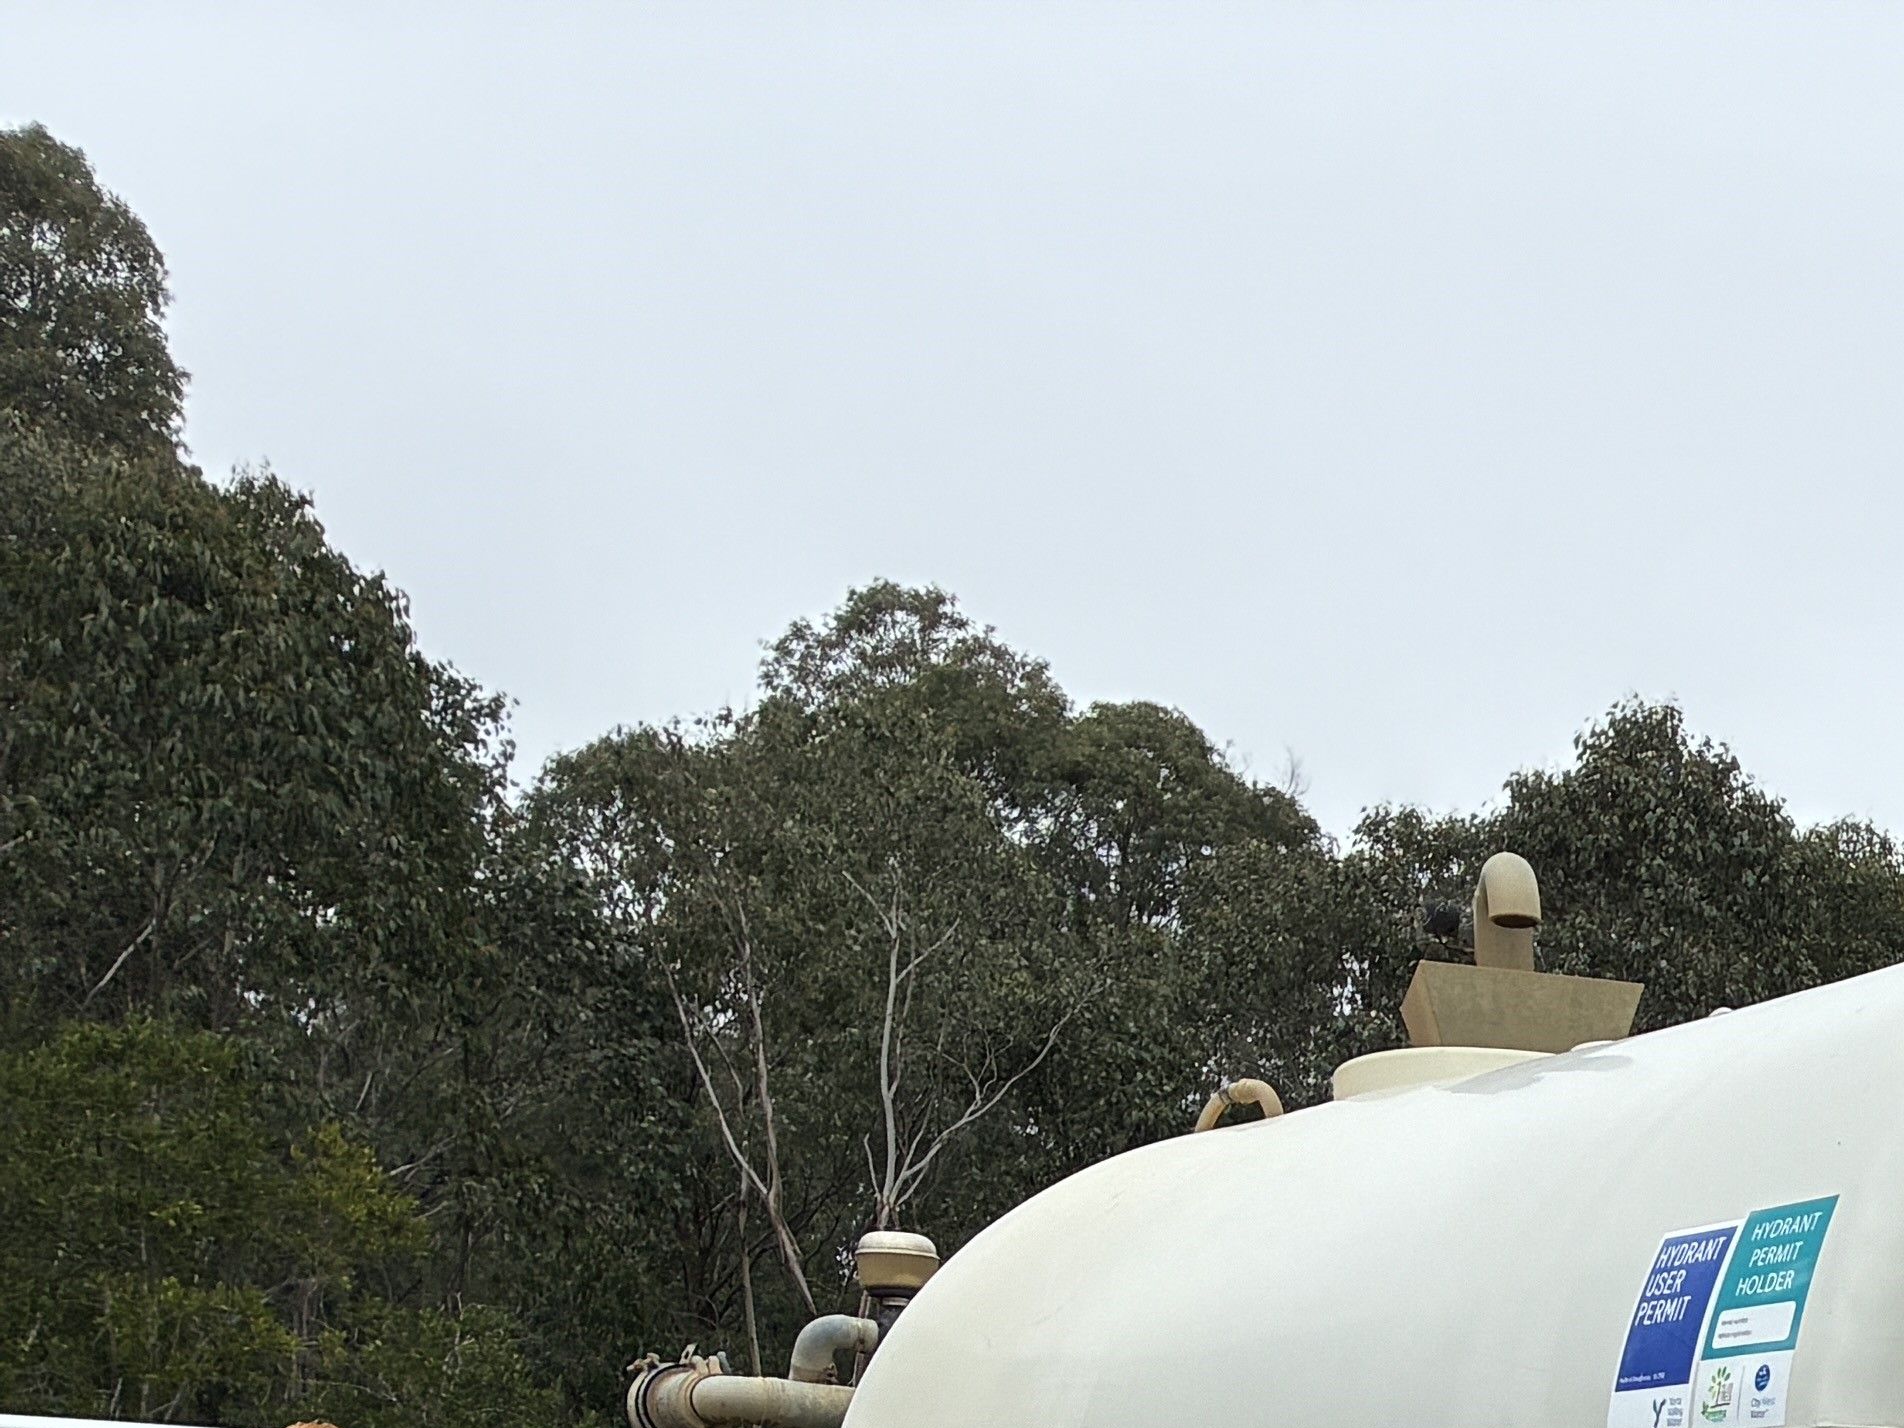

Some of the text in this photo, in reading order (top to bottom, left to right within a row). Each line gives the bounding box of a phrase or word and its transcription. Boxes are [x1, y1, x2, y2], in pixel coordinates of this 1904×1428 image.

[1752, 1211, 1824, 1242] HYDRANT
[1655, 1236, 1728, 1270] HYDRANT
[1749, 1241, 1804, 1268] PERMIT
[1646, 1270, 1687, 1298] USER
[1736, 1270, 1795, 1297] HOLDER
[1635, 1296, 1692, 1327] PERMIT
